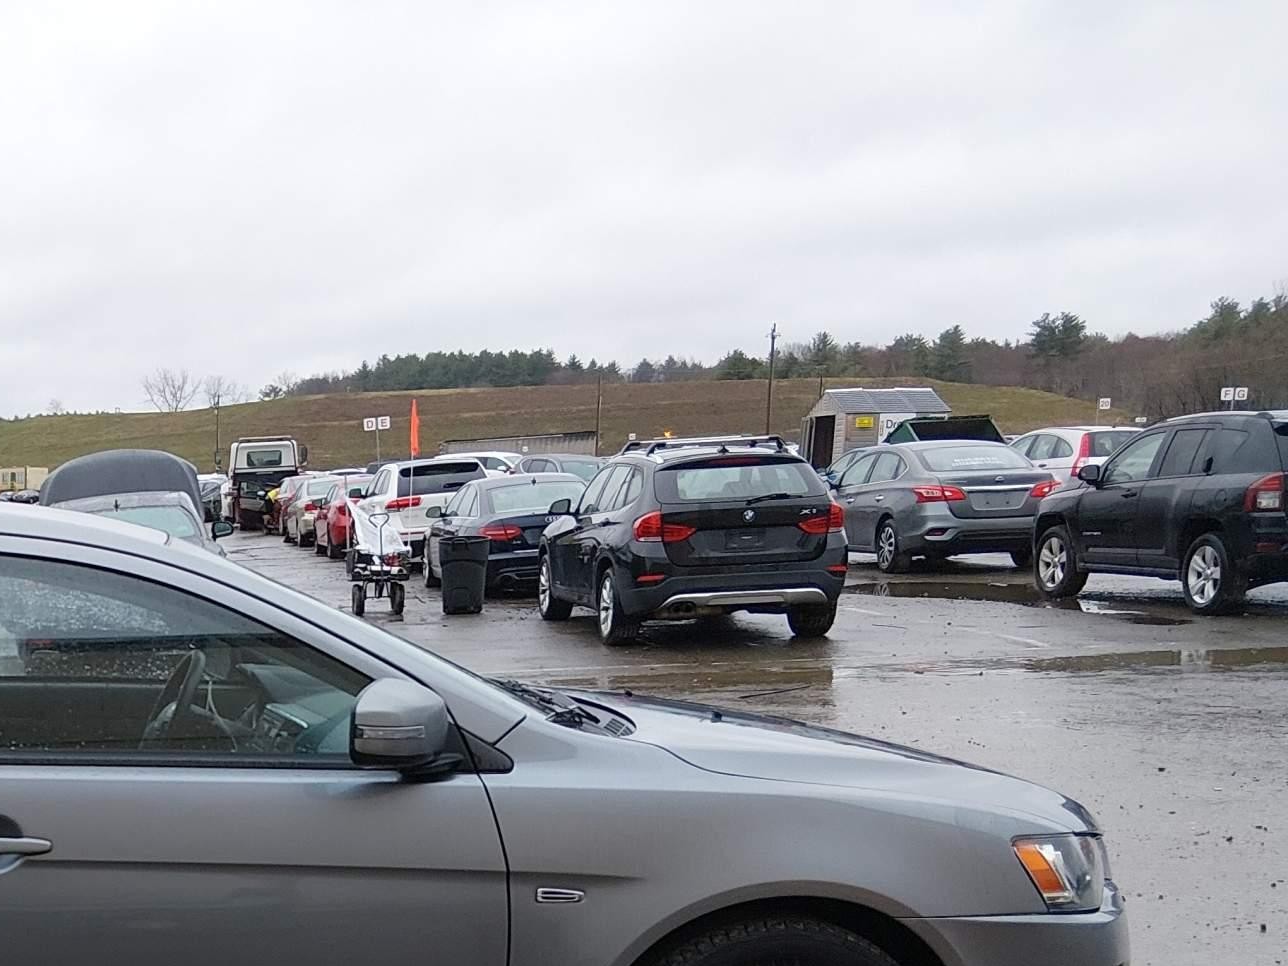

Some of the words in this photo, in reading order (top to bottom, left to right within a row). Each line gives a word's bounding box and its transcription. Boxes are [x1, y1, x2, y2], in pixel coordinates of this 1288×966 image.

[1224, 389, 1232, 399] F
[1237, 389, 1246, 399] G
[1100, 400, 1110, 409] 20
